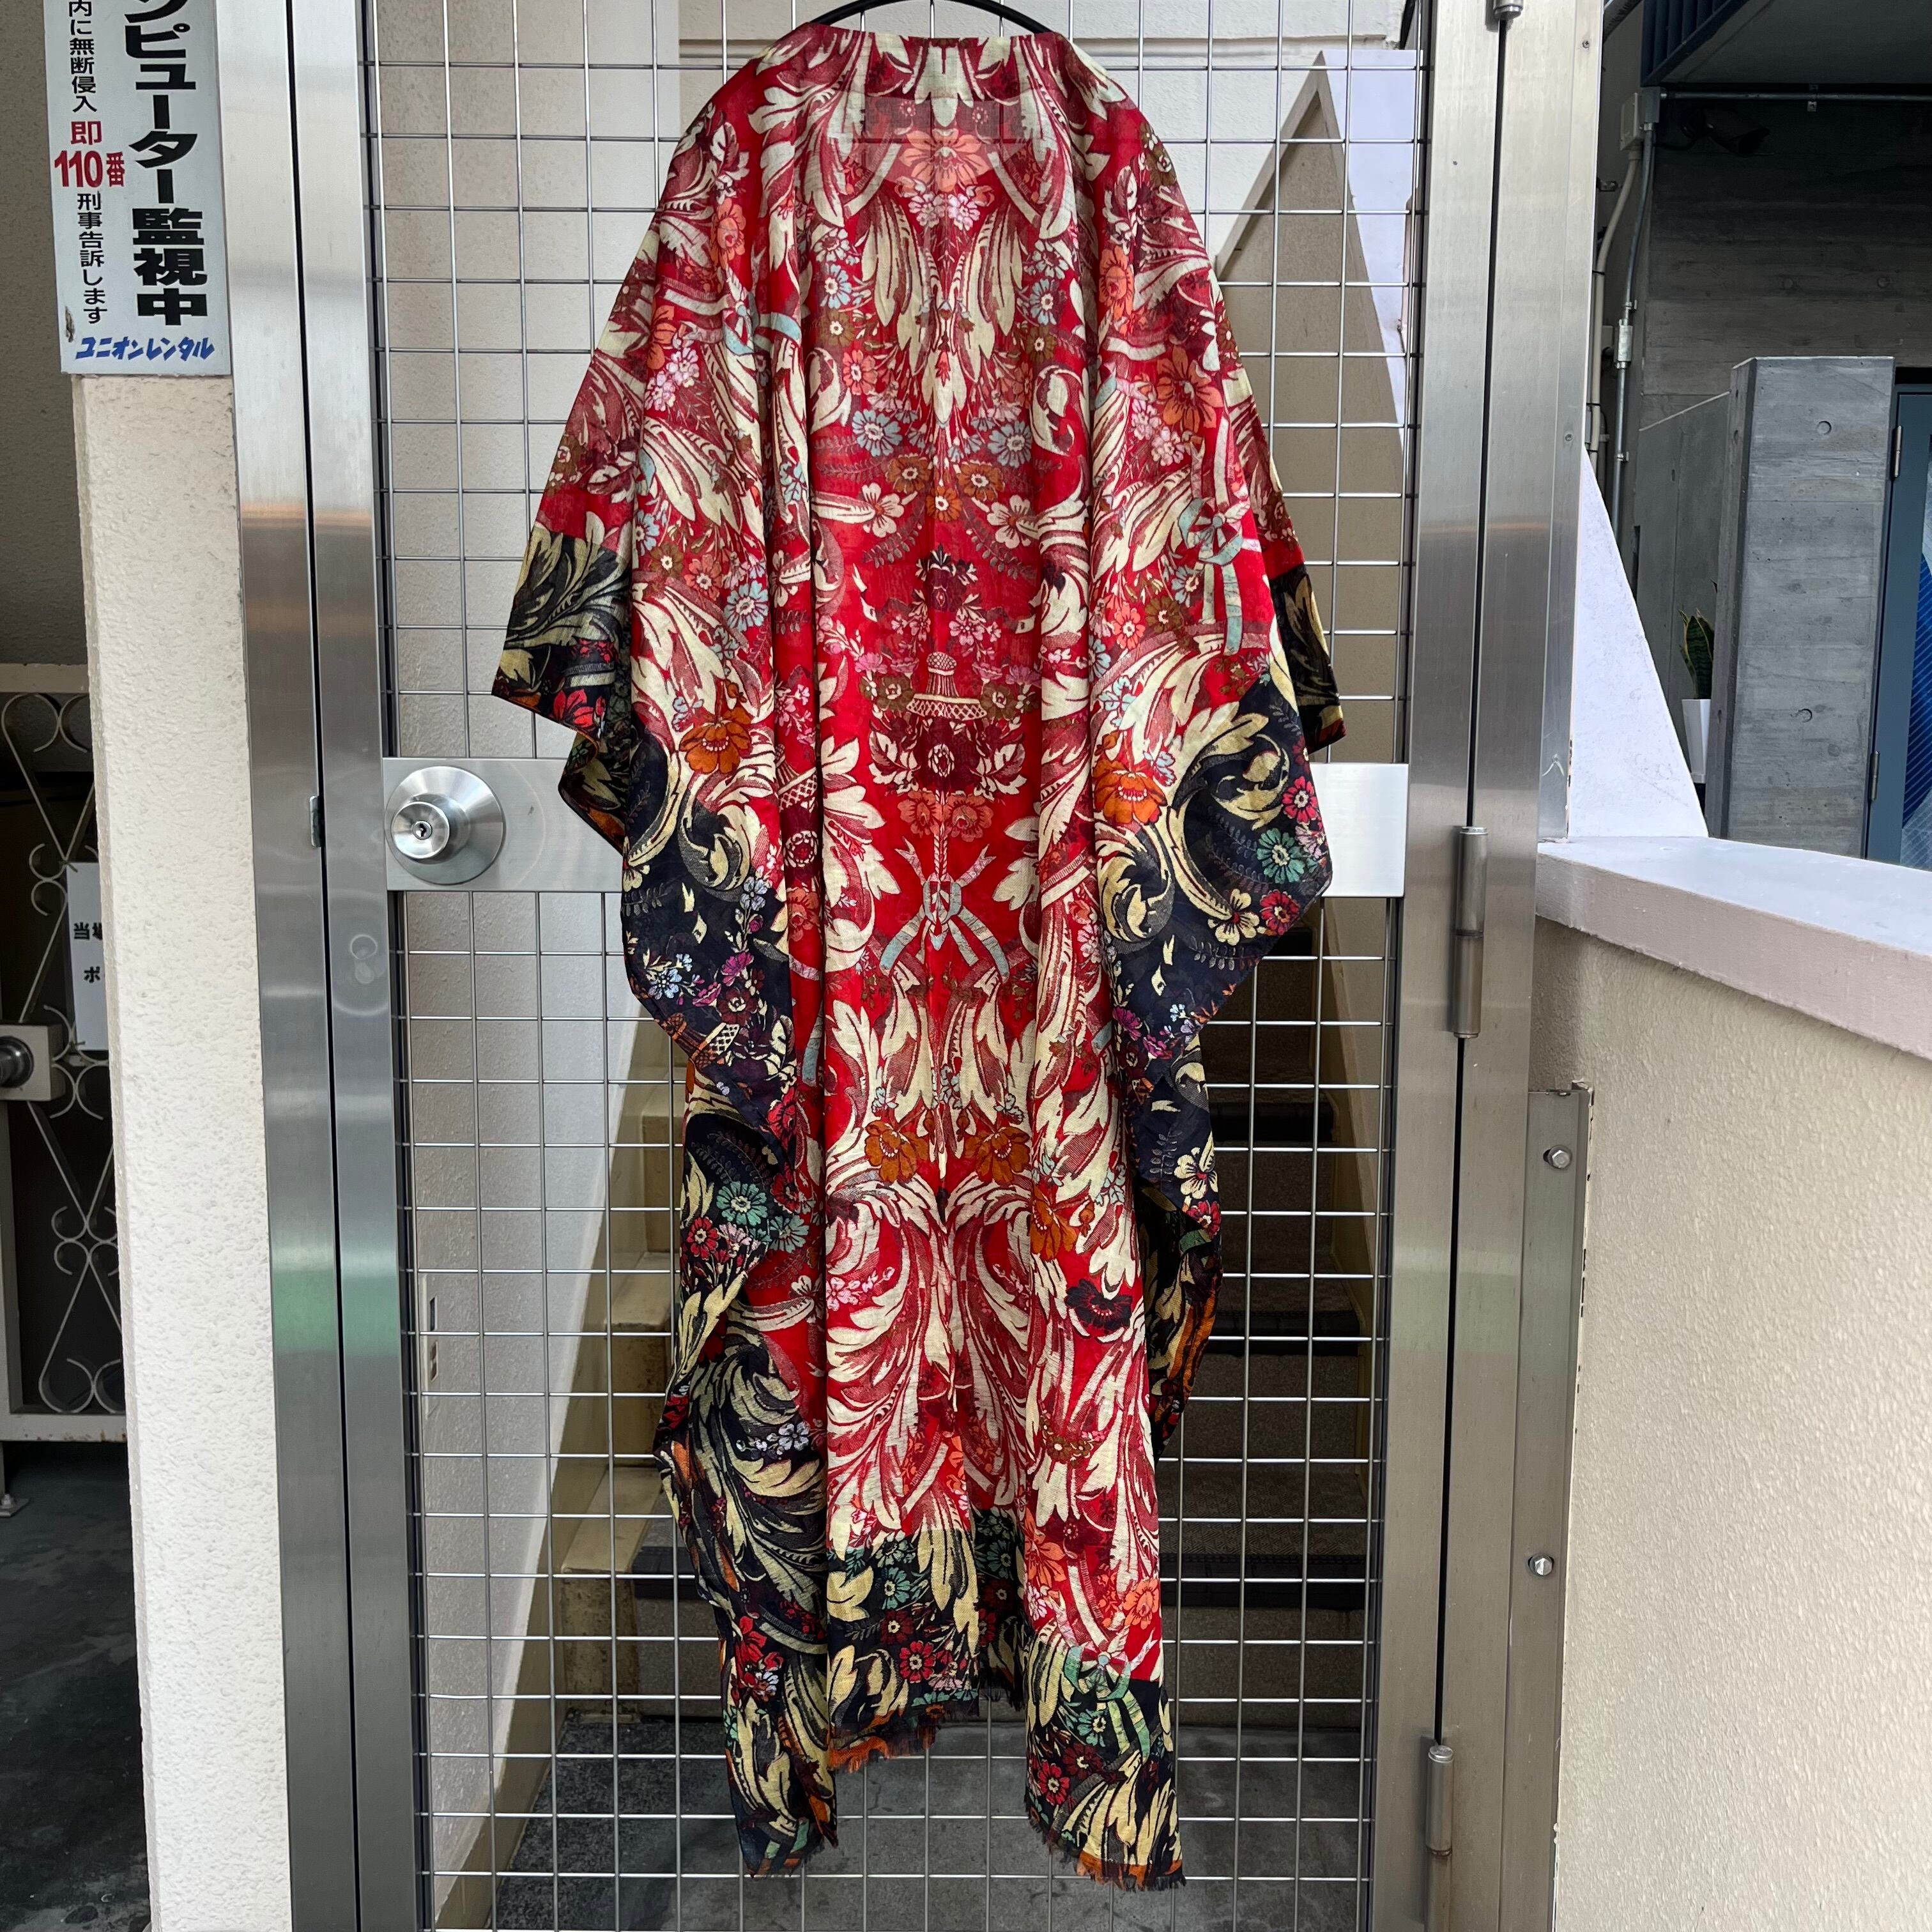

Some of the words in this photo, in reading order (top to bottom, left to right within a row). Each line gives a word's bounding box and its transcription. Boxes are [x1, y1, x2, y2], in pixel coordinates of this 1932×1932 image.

[75, 336, 215, 362] ユニオンレンタル
